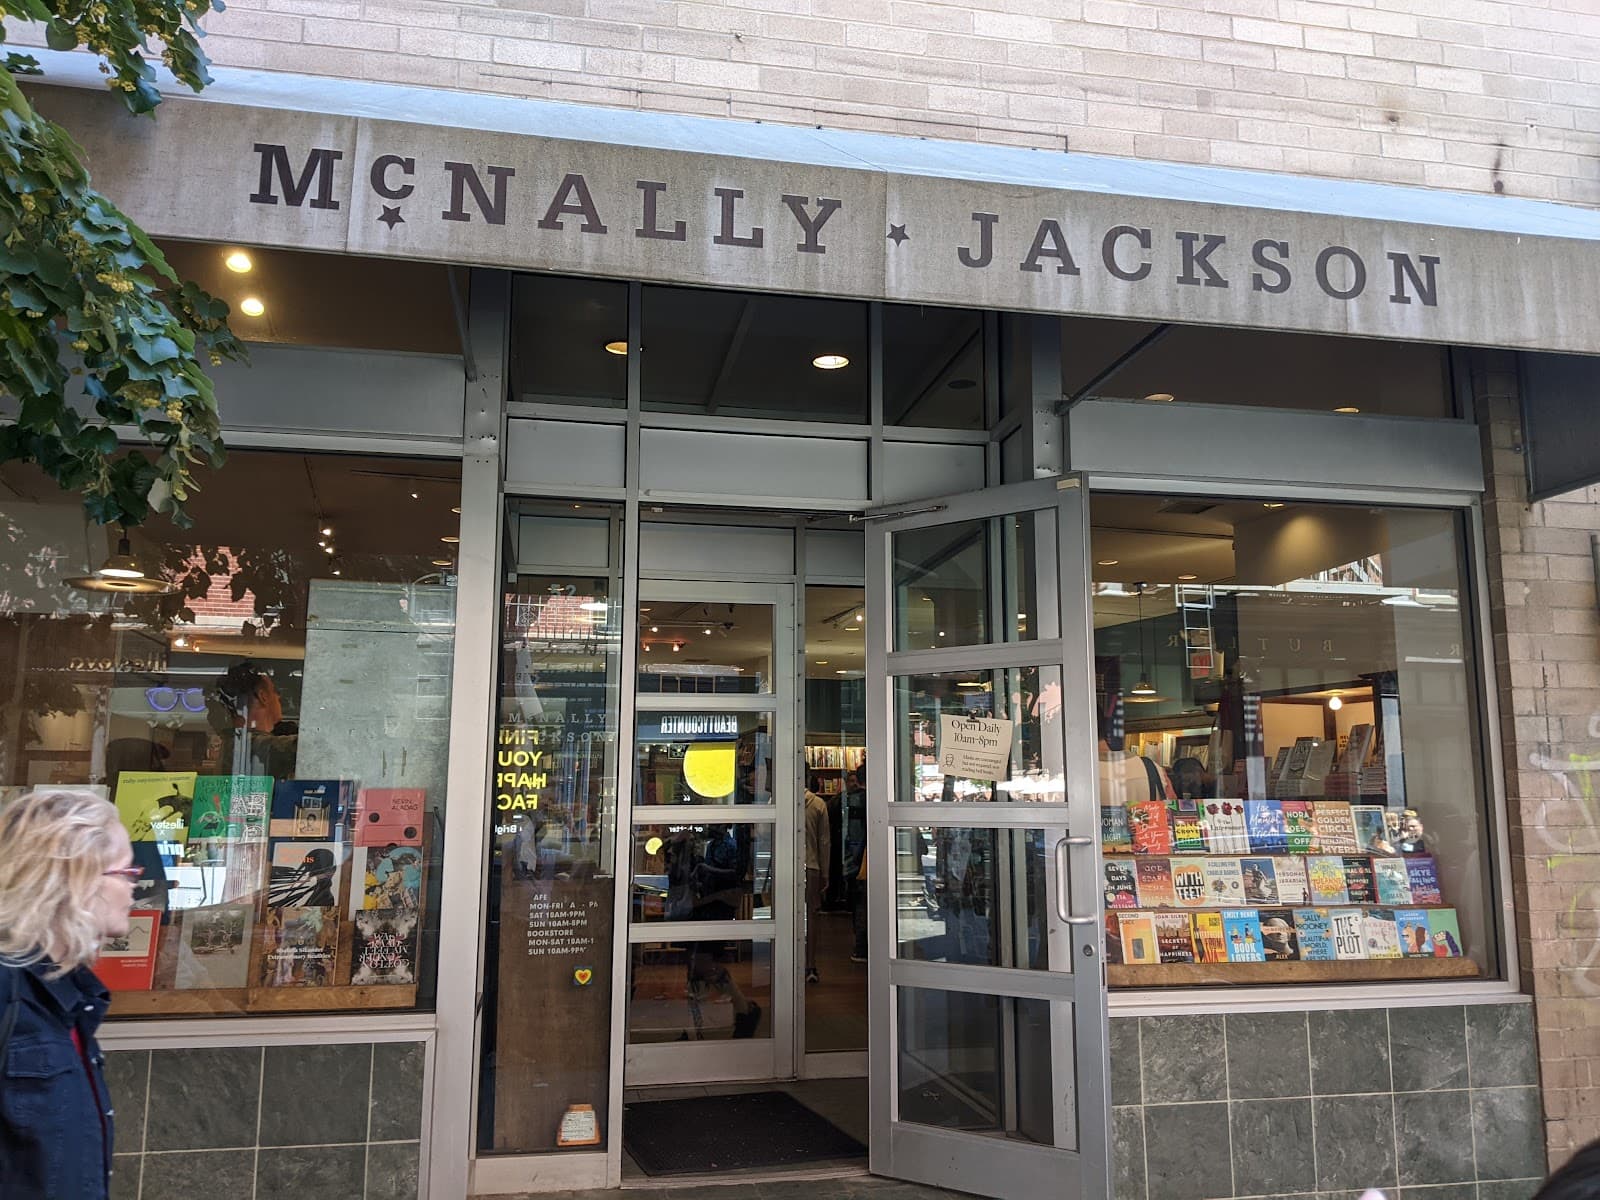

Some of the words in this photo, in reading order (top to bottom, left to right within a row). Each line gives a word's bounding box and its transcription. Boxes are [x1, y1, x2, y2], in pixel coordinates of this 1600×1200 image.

[957, 212, 1441, 306] JACKSON
[951, 719, 976, 732] Open
[978, 722, 1002, 736] Daily
[1318, 825, 1353, 833] CIRCLE
[1322, 846, 1357, 854] MYERS
[1175, 872, 1203, 886] WITH
[1176, 886, 1205, 900] TEETH
[529, 902, 563, 910] MON-FRI
[1302, 914, 1320, 922] SALLY
[1334, 916, 1354, 935] THE
[527, 929, 574, 937] BOOKSTORE
[1234, 943, 1256, 953] BOOK
[1336, 936, 1360, 954] PLOT
